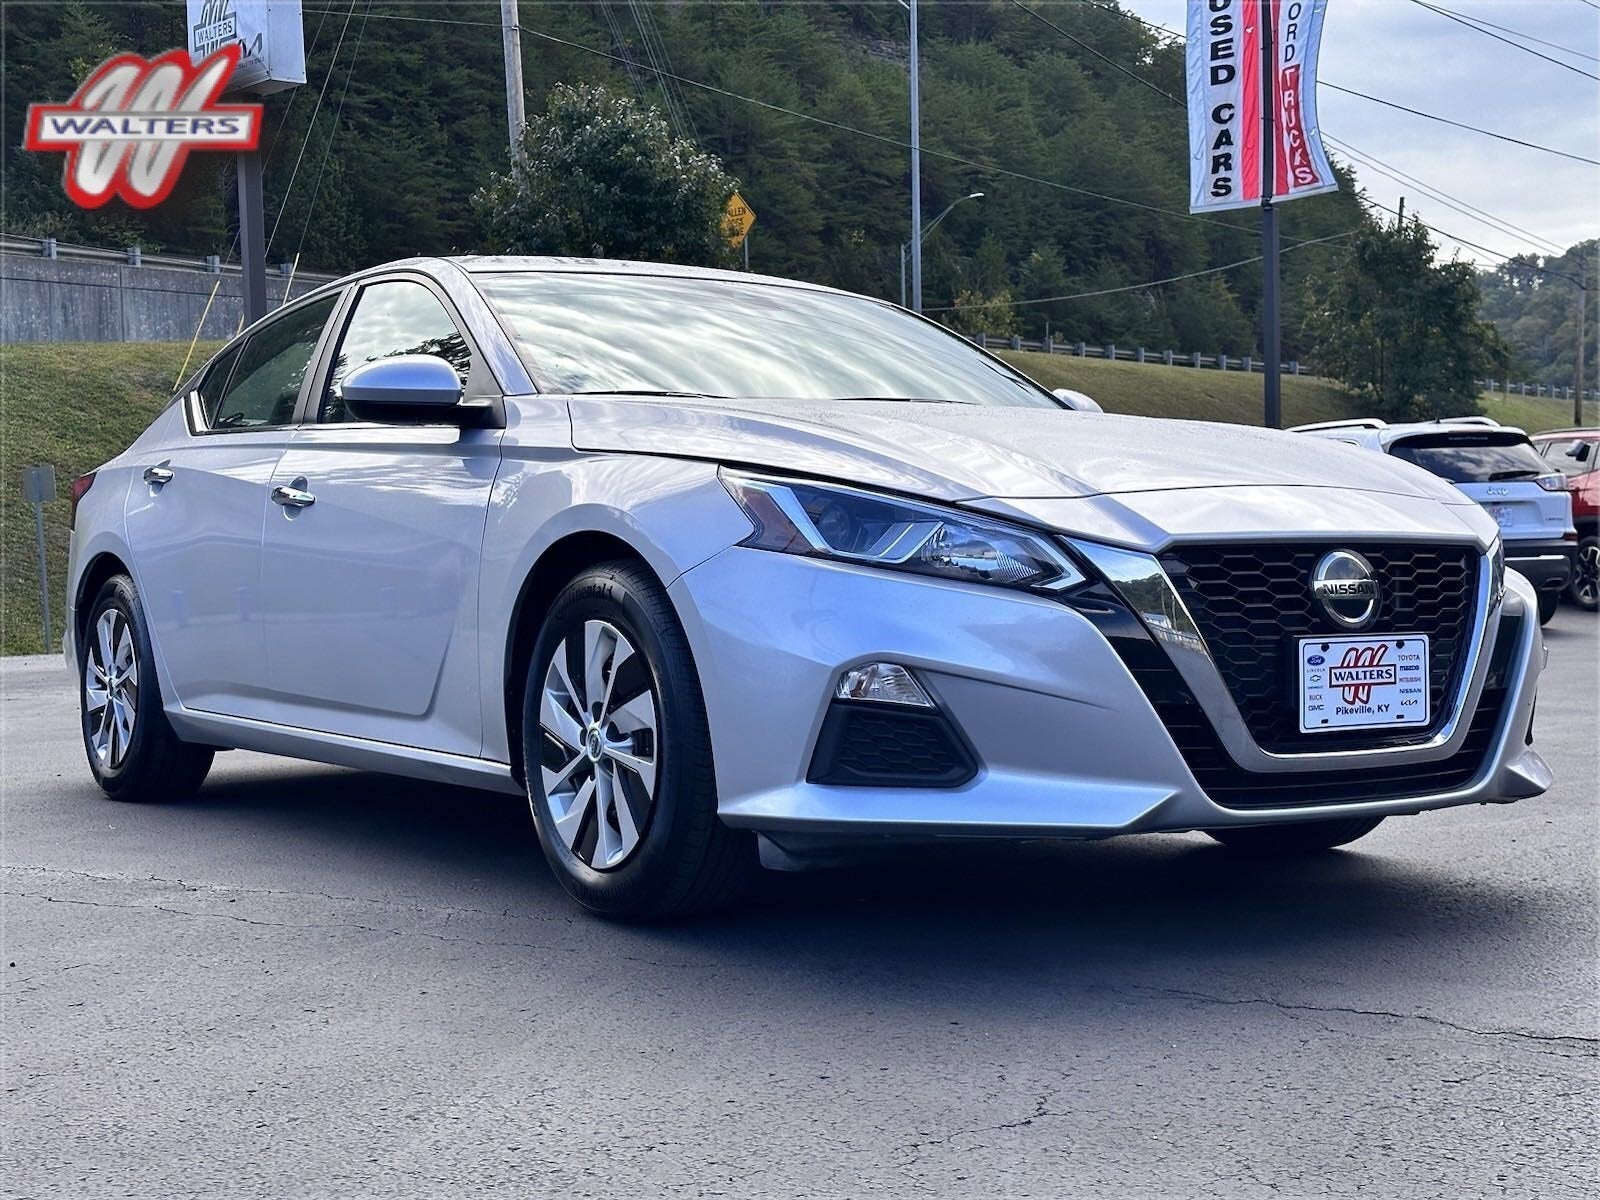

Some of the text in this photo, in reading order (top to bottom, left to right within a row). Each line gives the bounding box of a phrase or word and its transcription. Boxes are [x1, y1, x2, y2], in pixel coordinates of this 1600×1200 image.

[197, 21, 233, 44] WALTERS
[1209, 0, 1236, 197] USED CARS
[1283, 68, 1314, 185] TRUCKS
[1323, 583, 1374, 595] NISSAN
[1333, 668, 1393, 682] WALTERS
[1336, 703, 1390, 715] Pikeville, KY
